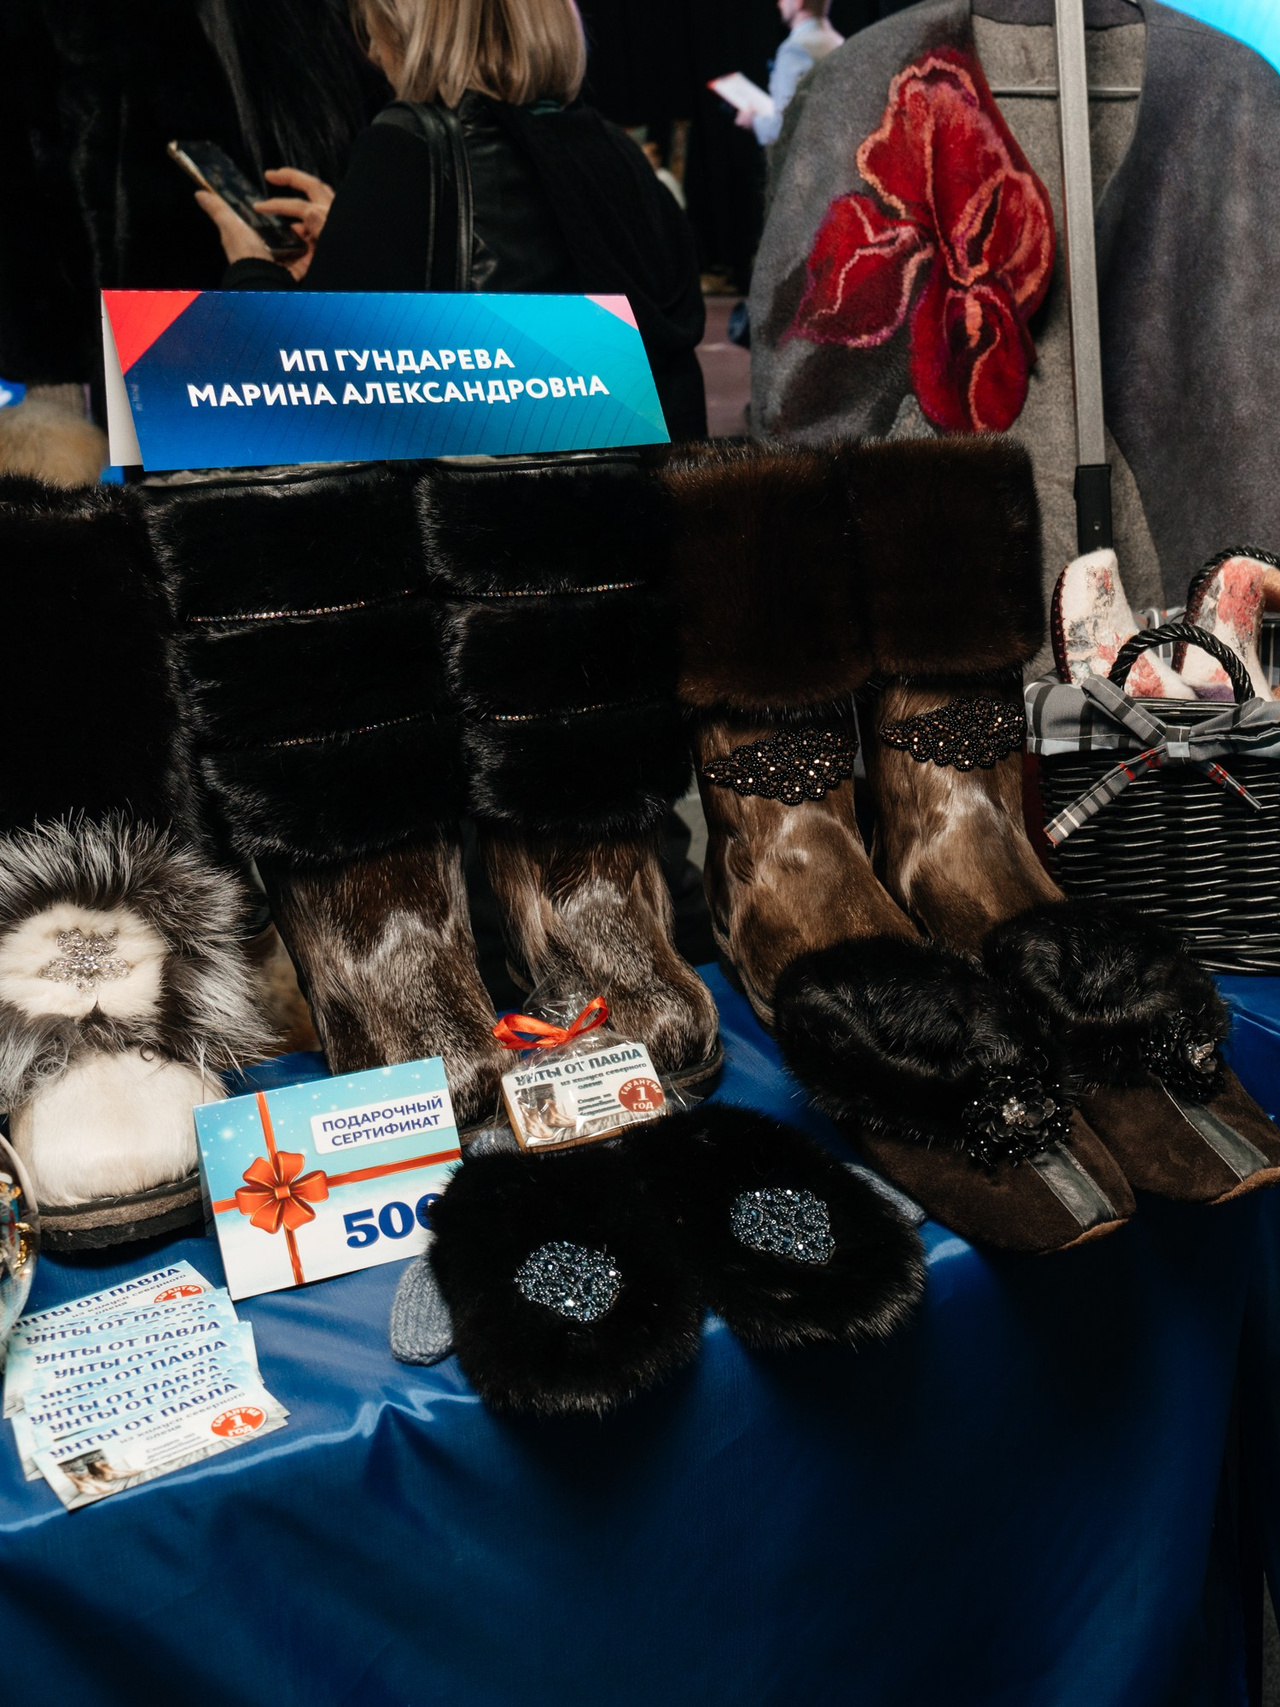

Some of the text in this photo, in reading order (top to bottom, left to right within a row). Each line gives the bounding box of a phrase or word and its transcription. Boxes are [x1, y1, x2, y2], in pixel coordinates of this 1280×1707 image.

[279, 348, 516, 375] ИП ГУНДАРЕВА
[186, 375, 611, 408] МАРИНА АЛЕКСАНДРОВНА
[564, 1061, 586, 1075] ОТ
[588, 1048, 643, 1069] ПАВЛА
[605, 1062, 647, 1077] северного
[632, 1101, 654, 1110] ГОД
[636, 1086, 649, 1101] 1
[322, 1096, 443, 1133] ПОДАРОЧНЫЙ
[331, 1114, 440, 1147] СЕРТИФИКАТ
[76, 1294, 104, 1309] ОТ
[109, 1268, 181, 1297] ПАВЛА
[26, 1326, 91, 1345] УНТЫ
[97, 1318, 128, 1331] ОТ
[35, 1345, 101, 1364] УНТЫ
[108, 1337, 139, 1351] ОТ
[145, 1321, 221, 1344] ПАВЛА
[54, 1349, 158, 1379] УНТЫ ОТ
[114, 1365, 145, 1380] ОТ
[151, 1340, 228, 1370] ПАВЛА
[29, 1400, 100, 1425] УНТЫ
[106, 1389, 137, 1404] ОТ
[49, 1407, 120, 1433] УНТЫ
[125, 1395, 156, 1411] ОТ
[49, 1429, 120, 1458] УНТЫ
[125, 1414, 155, 1431] ОТ
[161, 1383, 239, 1418] ПАВЛА
[229, 1415, 248, 1429] 1
[227, 1424, 254, 1437] ГОД
